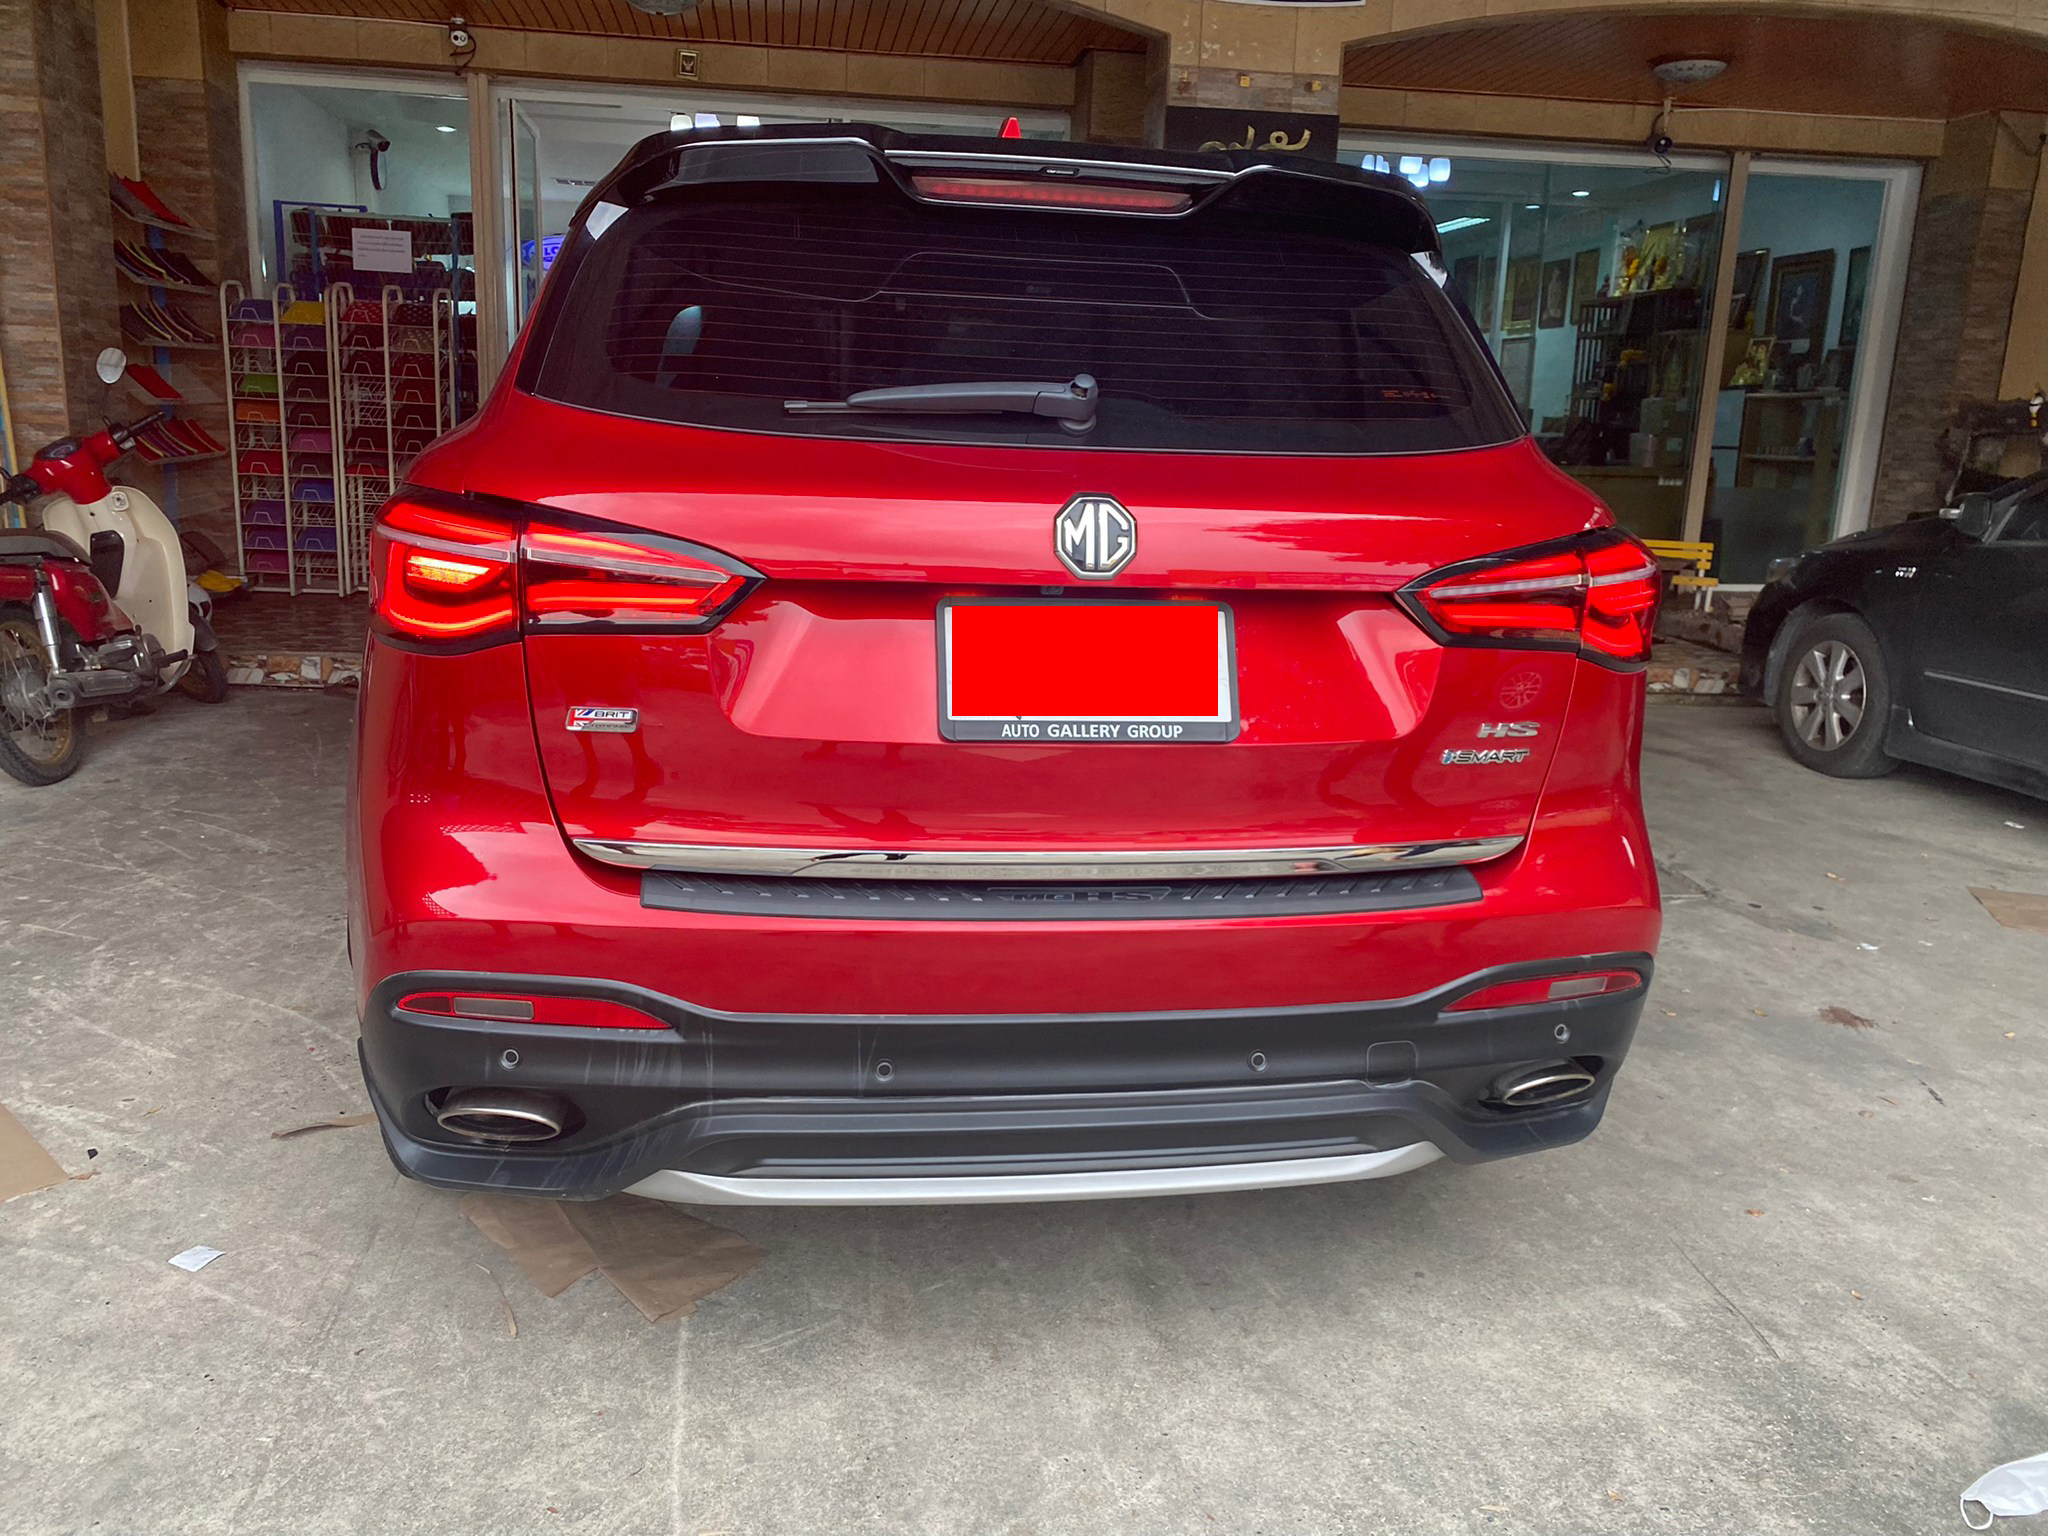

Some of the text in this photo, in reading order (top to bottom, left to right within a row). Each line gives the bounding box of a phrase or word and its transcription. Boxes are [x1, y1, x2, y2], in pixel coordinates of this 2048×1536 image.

[1063, 502, 1130, 570] MG
[594, 710, 630, 718] BRIT
[1001, 723, 1184, 739] AUTO GALLERY GROUP
[1476, 721, 1540, 738] HS
